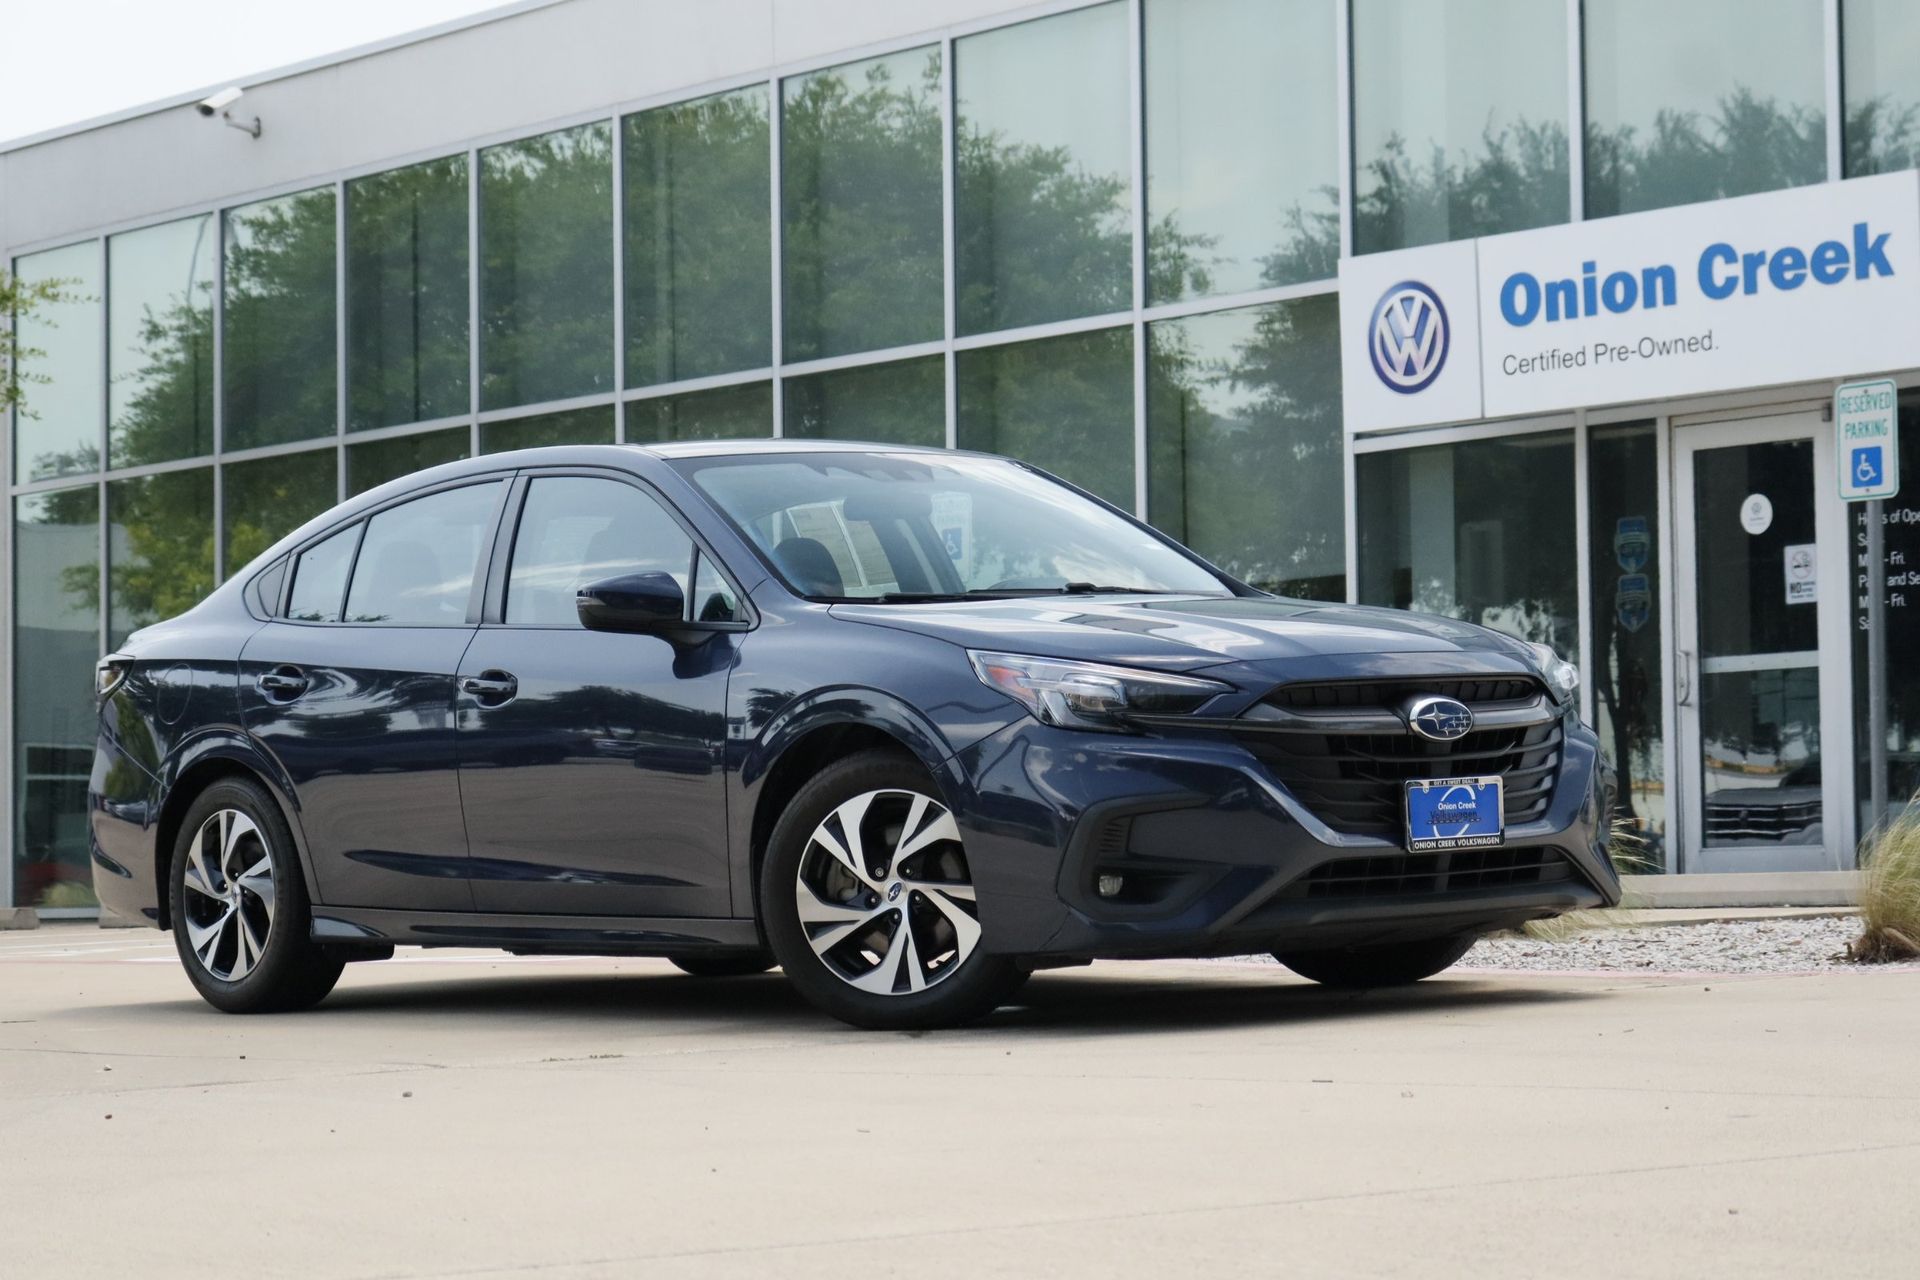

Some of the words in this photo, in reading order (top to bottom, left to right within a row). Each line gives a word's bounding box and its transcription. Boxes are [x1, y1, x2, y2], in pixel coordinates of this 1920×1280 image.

[1500, 261, 1676, 327] Onion
[1698, 222, 1895, 300] Creek
[1502, 343, 1587, 376] Certified
[1594, 330, 1720, 364] Pre-Owned.
[1841, 392, 1891, 413] RESERVED
[1845, 419, 1888, 439] PARKING
[1887, 572, 1906, 586] and
[1458, 801, 1476, 809] Creek
[1414, 841, 1437, 850] ONION
[1438, 839, 1456, 848] CREEK
[1457, 837, 1500, 847] VOLKSWAGEN
